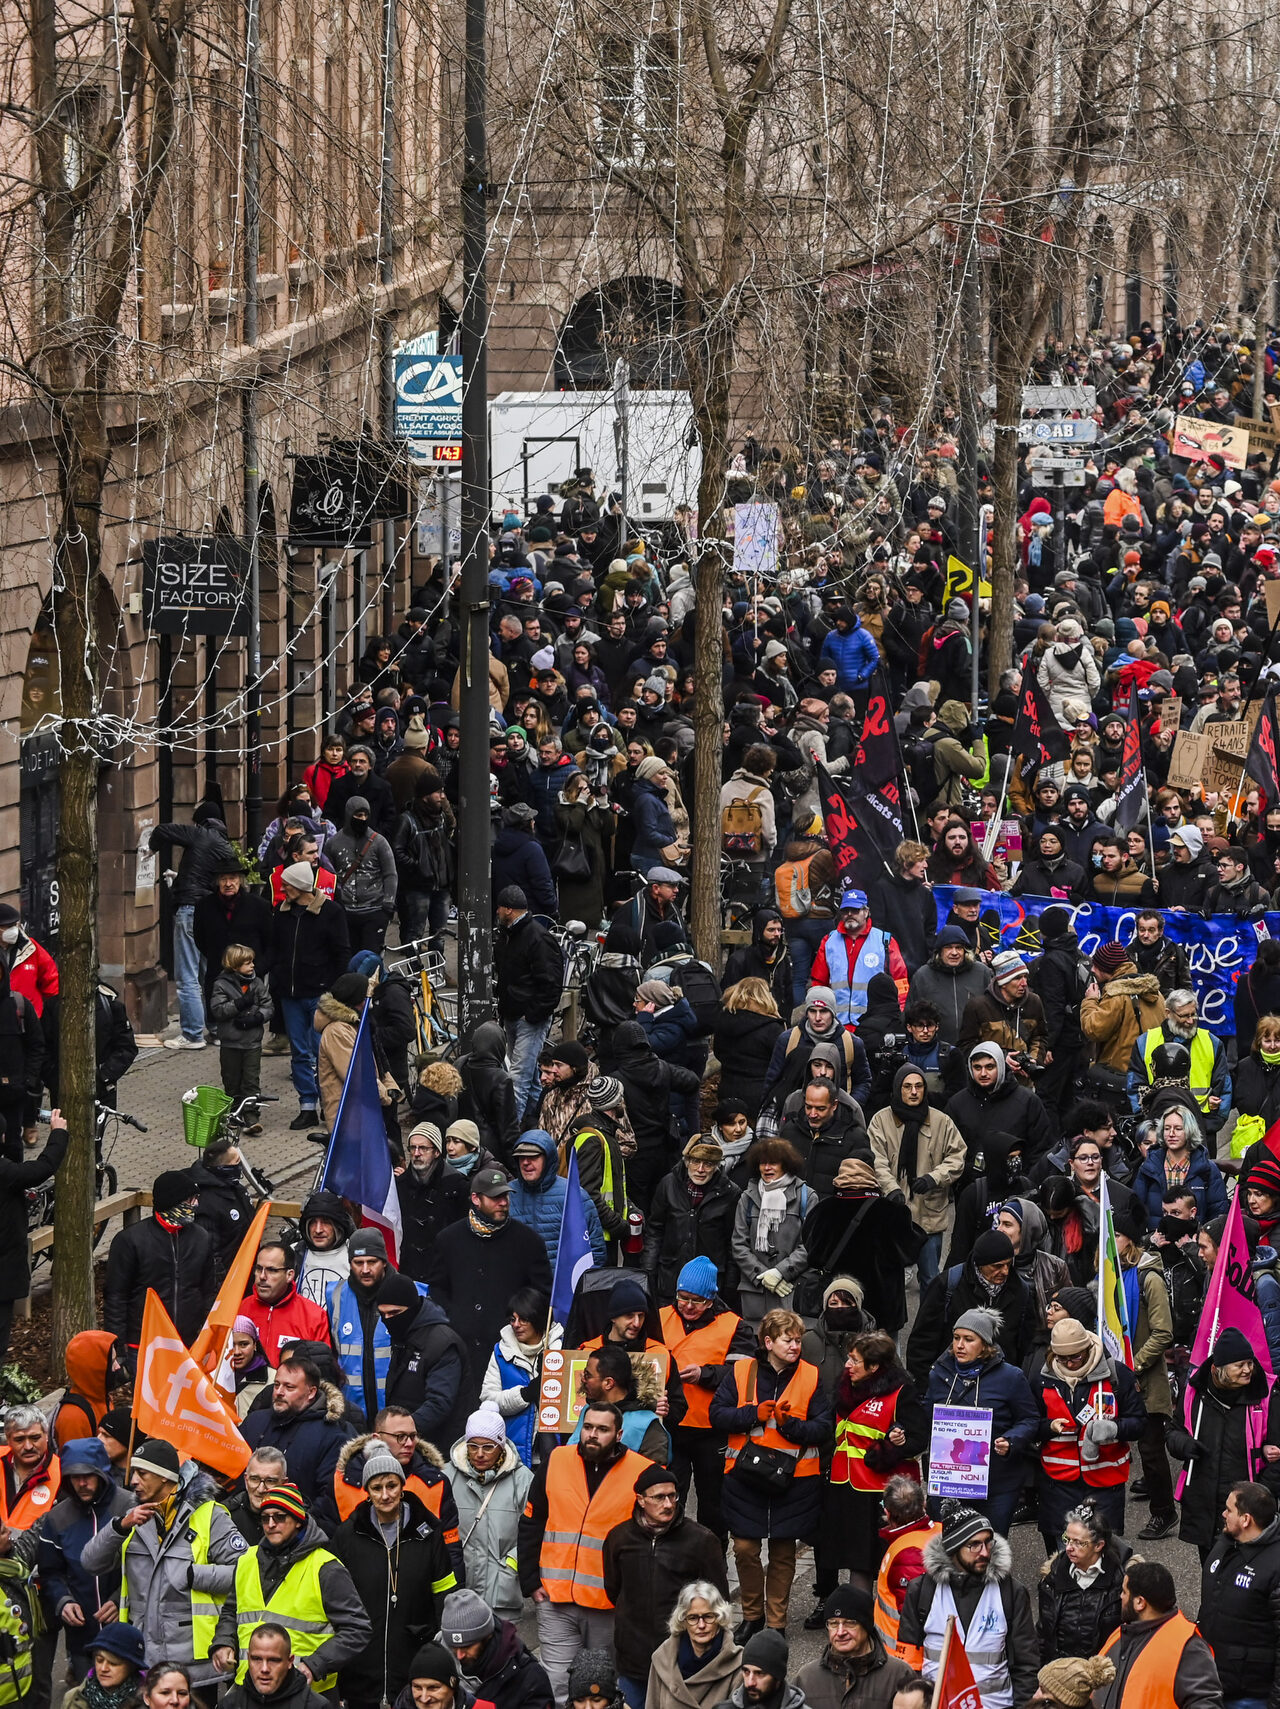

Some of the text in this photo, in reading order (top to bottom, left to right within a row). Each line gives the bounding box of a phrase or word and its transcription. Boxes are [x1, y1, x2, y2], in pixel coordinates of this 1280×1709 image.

[160, 563, 228, 586] SIZE
[161, 592, 242, 605] FACTORY
[1208, 723, 1247, 737] RETRAITE
[1213, 738, 1244, 749] 64 ANS
[160, 1418, 176, 1428] des
[204, 1432, 219, 1444] des
[221, 1439, 246, 1453] actes
[1235, 1574, 1251, 1588] CFTC
